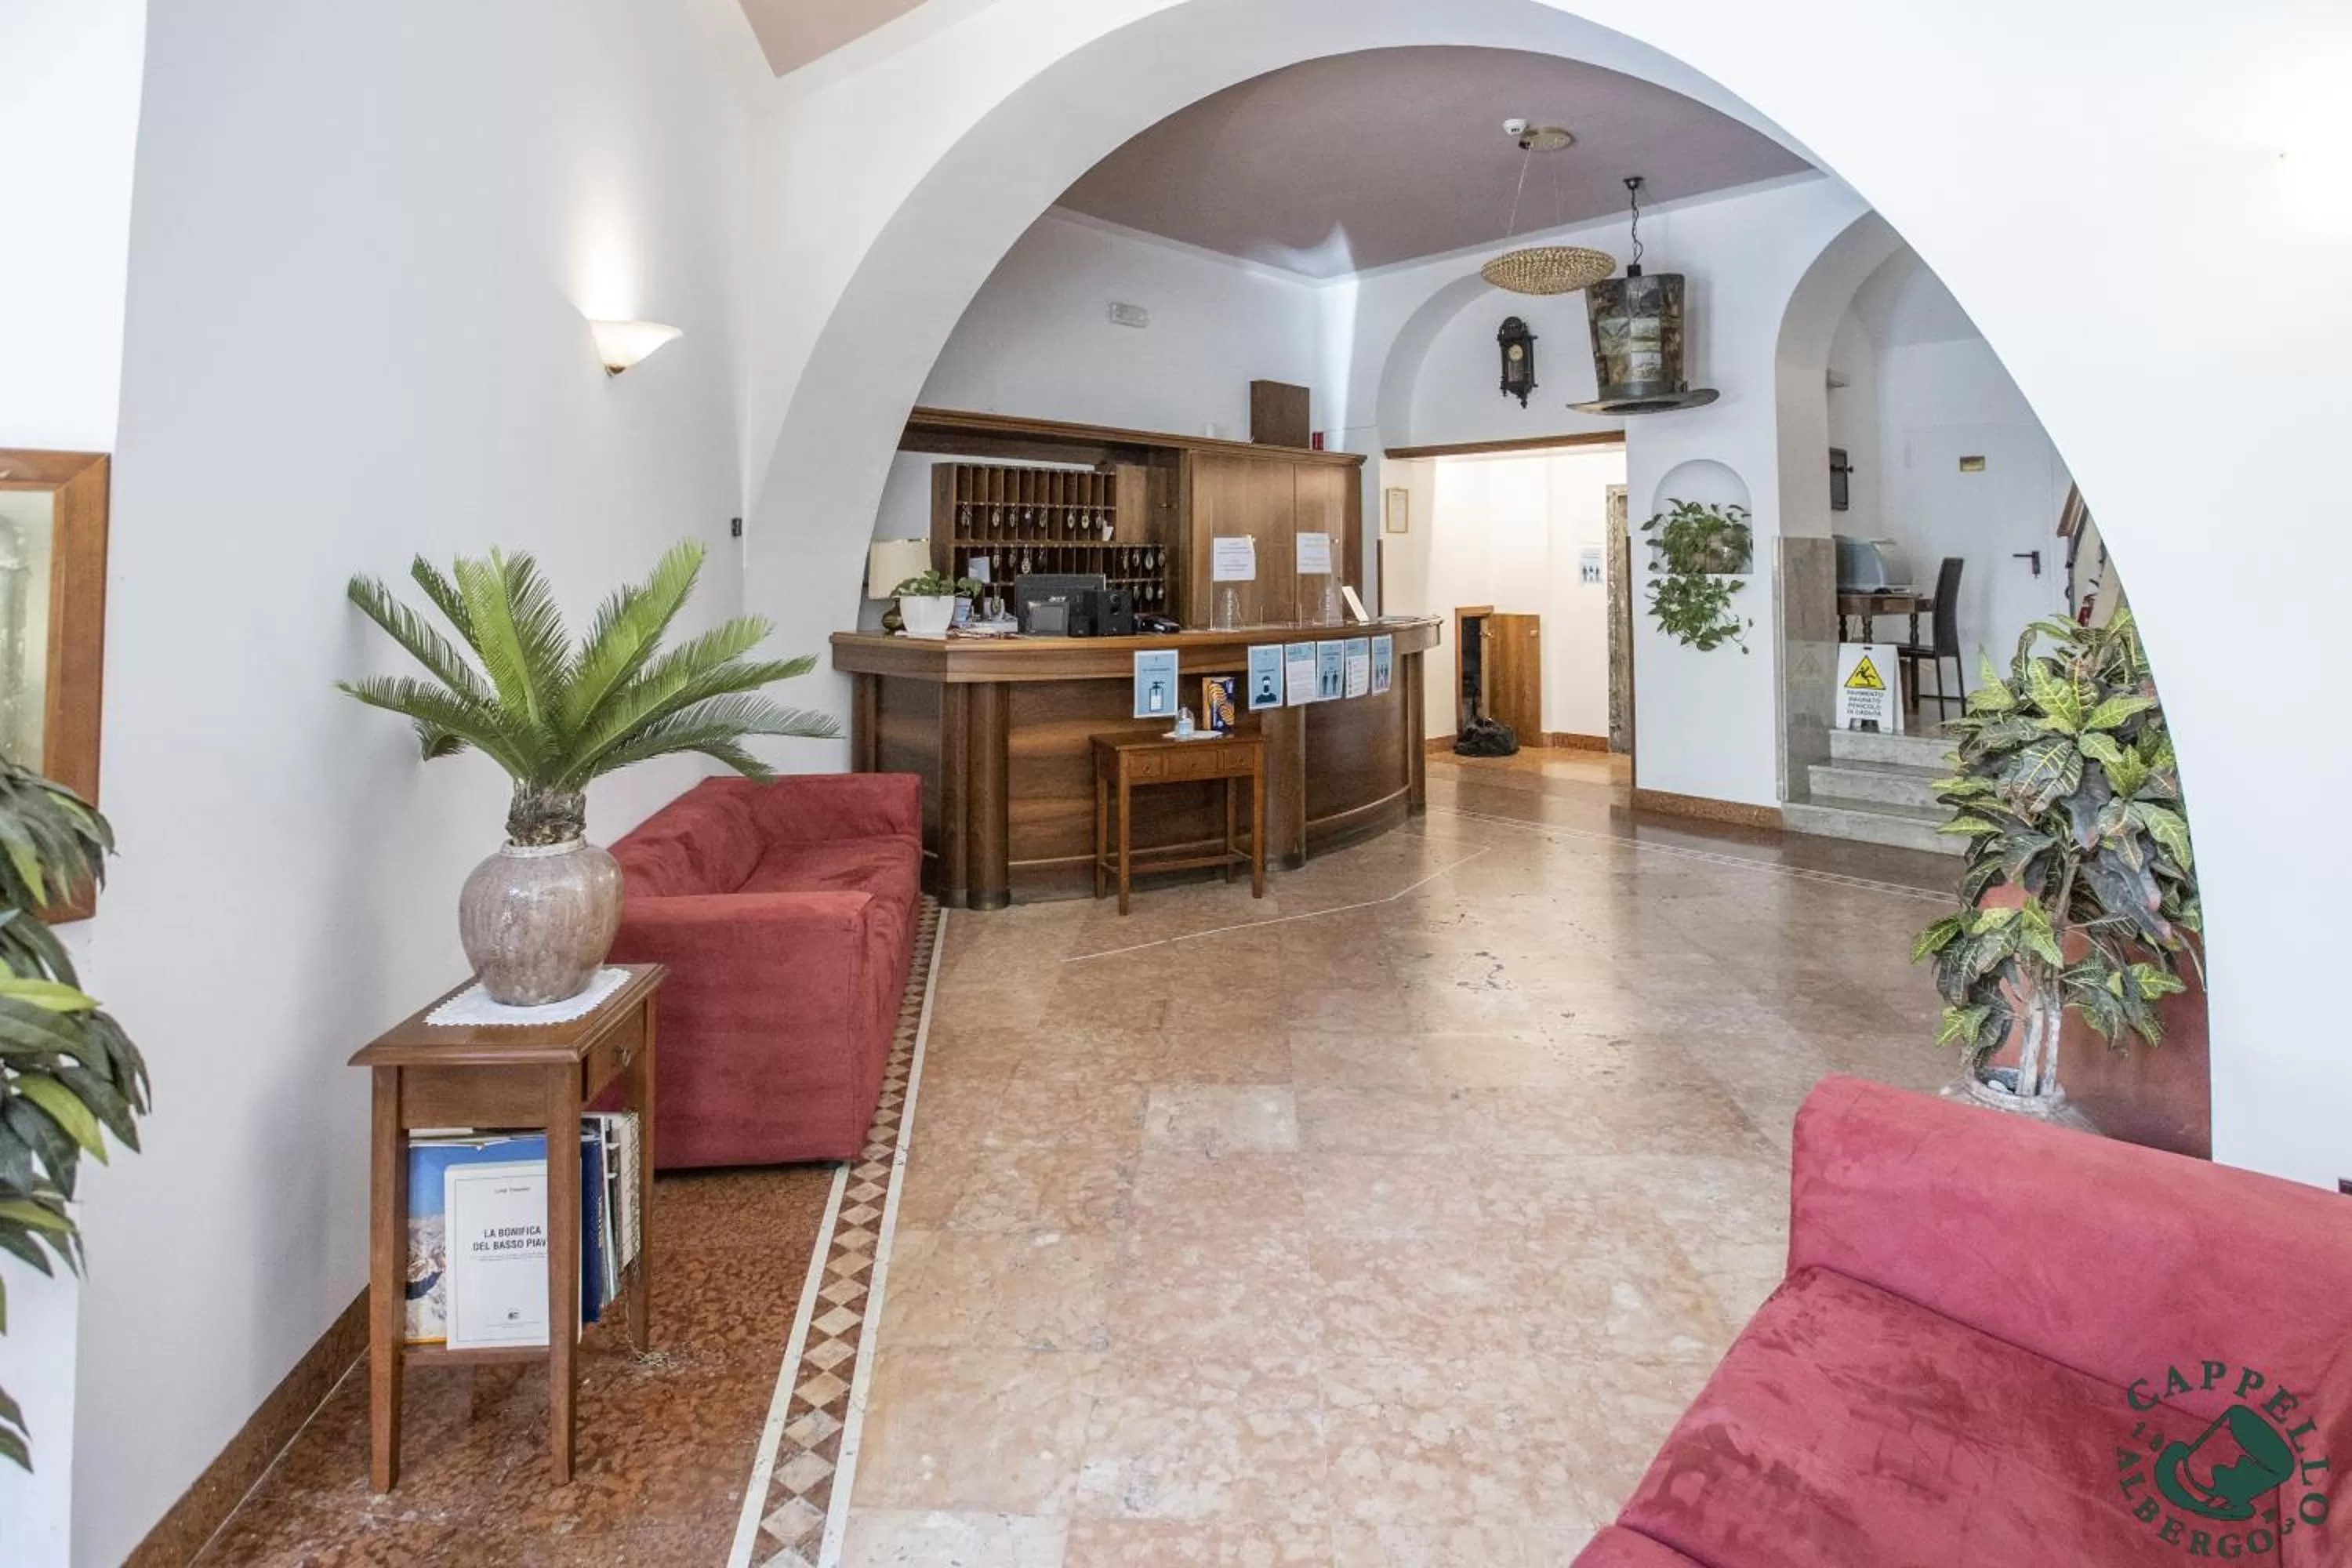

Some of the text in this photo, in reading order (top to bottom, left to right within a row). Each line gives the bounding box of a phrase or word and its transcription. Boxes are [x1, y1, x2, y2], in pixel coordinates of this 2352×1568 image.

[484, 1225, 542, 1239] LA BONIFICA
[473, 1238, 546, 1251] DEL BASSO PIAV
